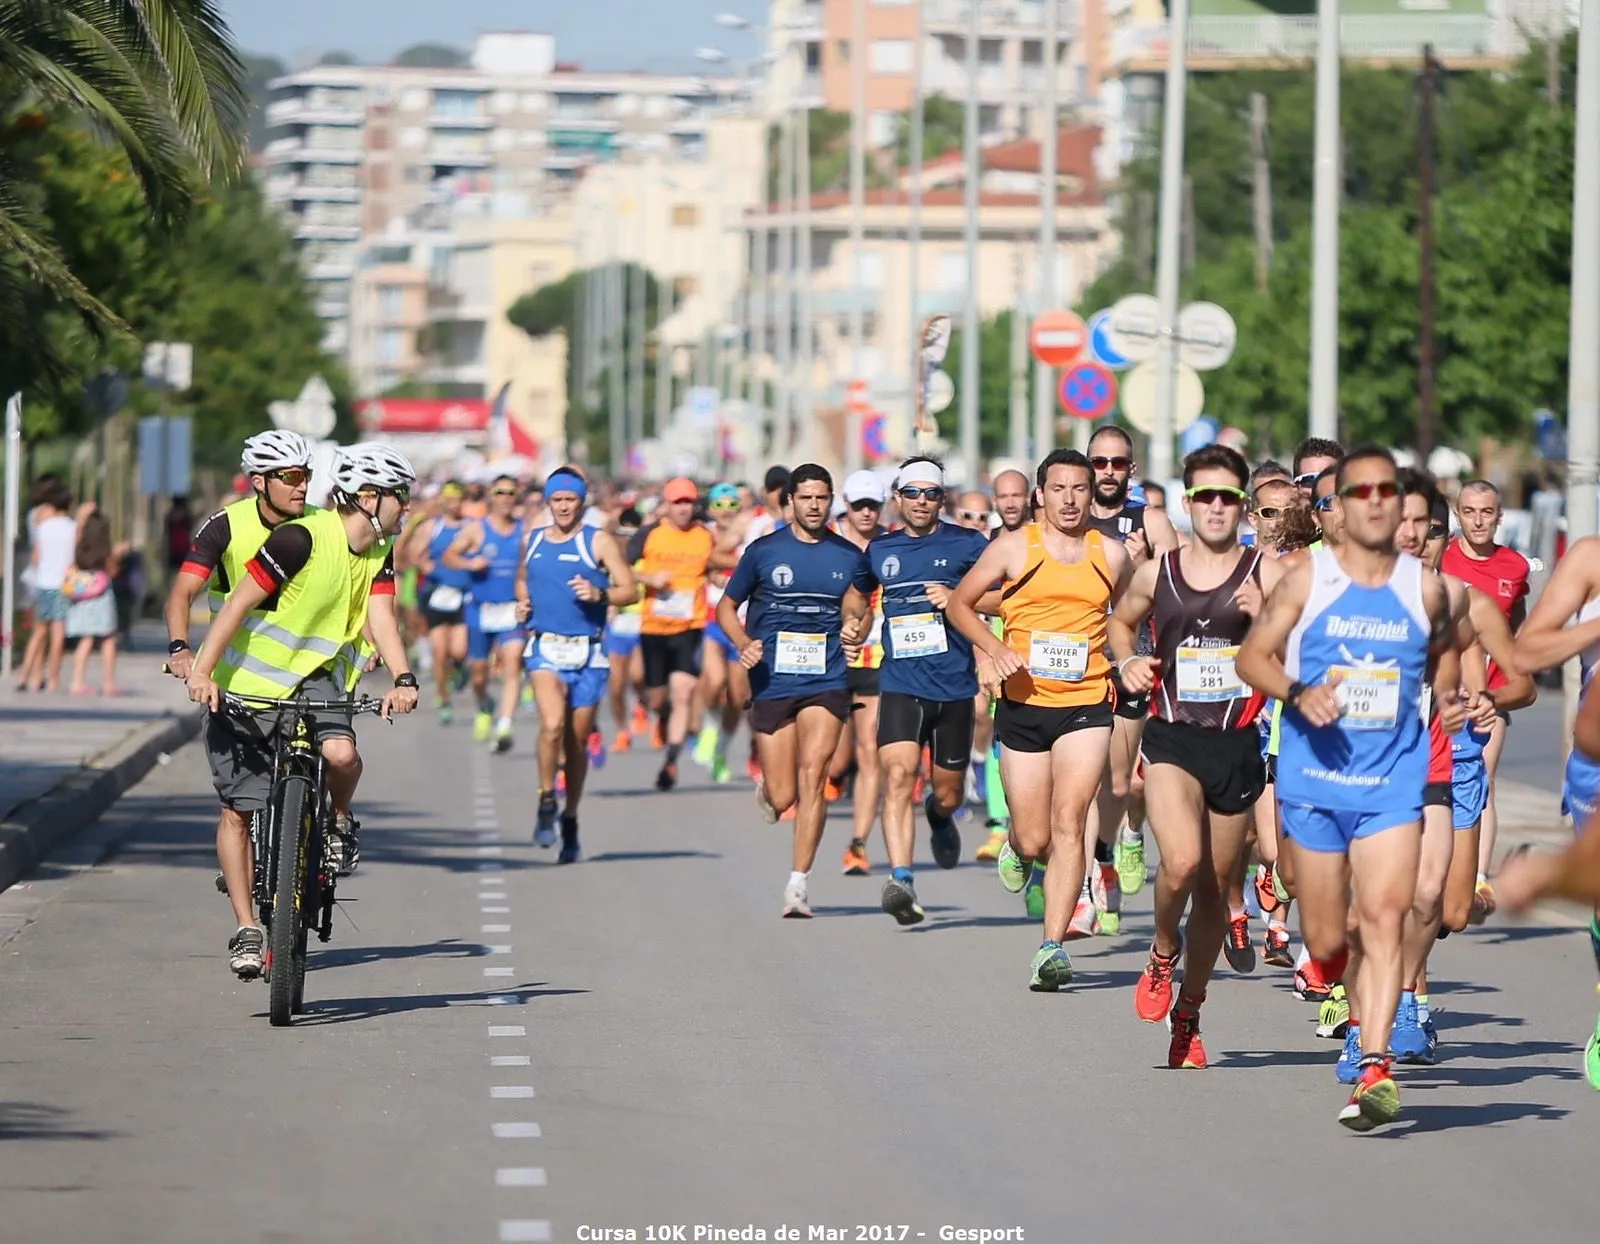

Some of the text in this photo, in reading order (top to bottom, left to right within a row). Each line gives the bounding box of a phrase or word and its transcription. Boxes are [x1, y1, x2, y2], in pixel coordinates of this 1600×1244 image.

[904, 631, 926, 643] 459
[785, 645, 818, 654] CARLOS
[1042, 646, 1078, 657] XAVIER
[796, 655, 808, 664] 25
[1049, 657, 1070, 668] 385
[1200, 664, 1223, 674] POL
[1200, 676, 1224, 688] 381
[1346, 686, 1379, 698] TONI
[1353, 700, 1370, 713] 10
